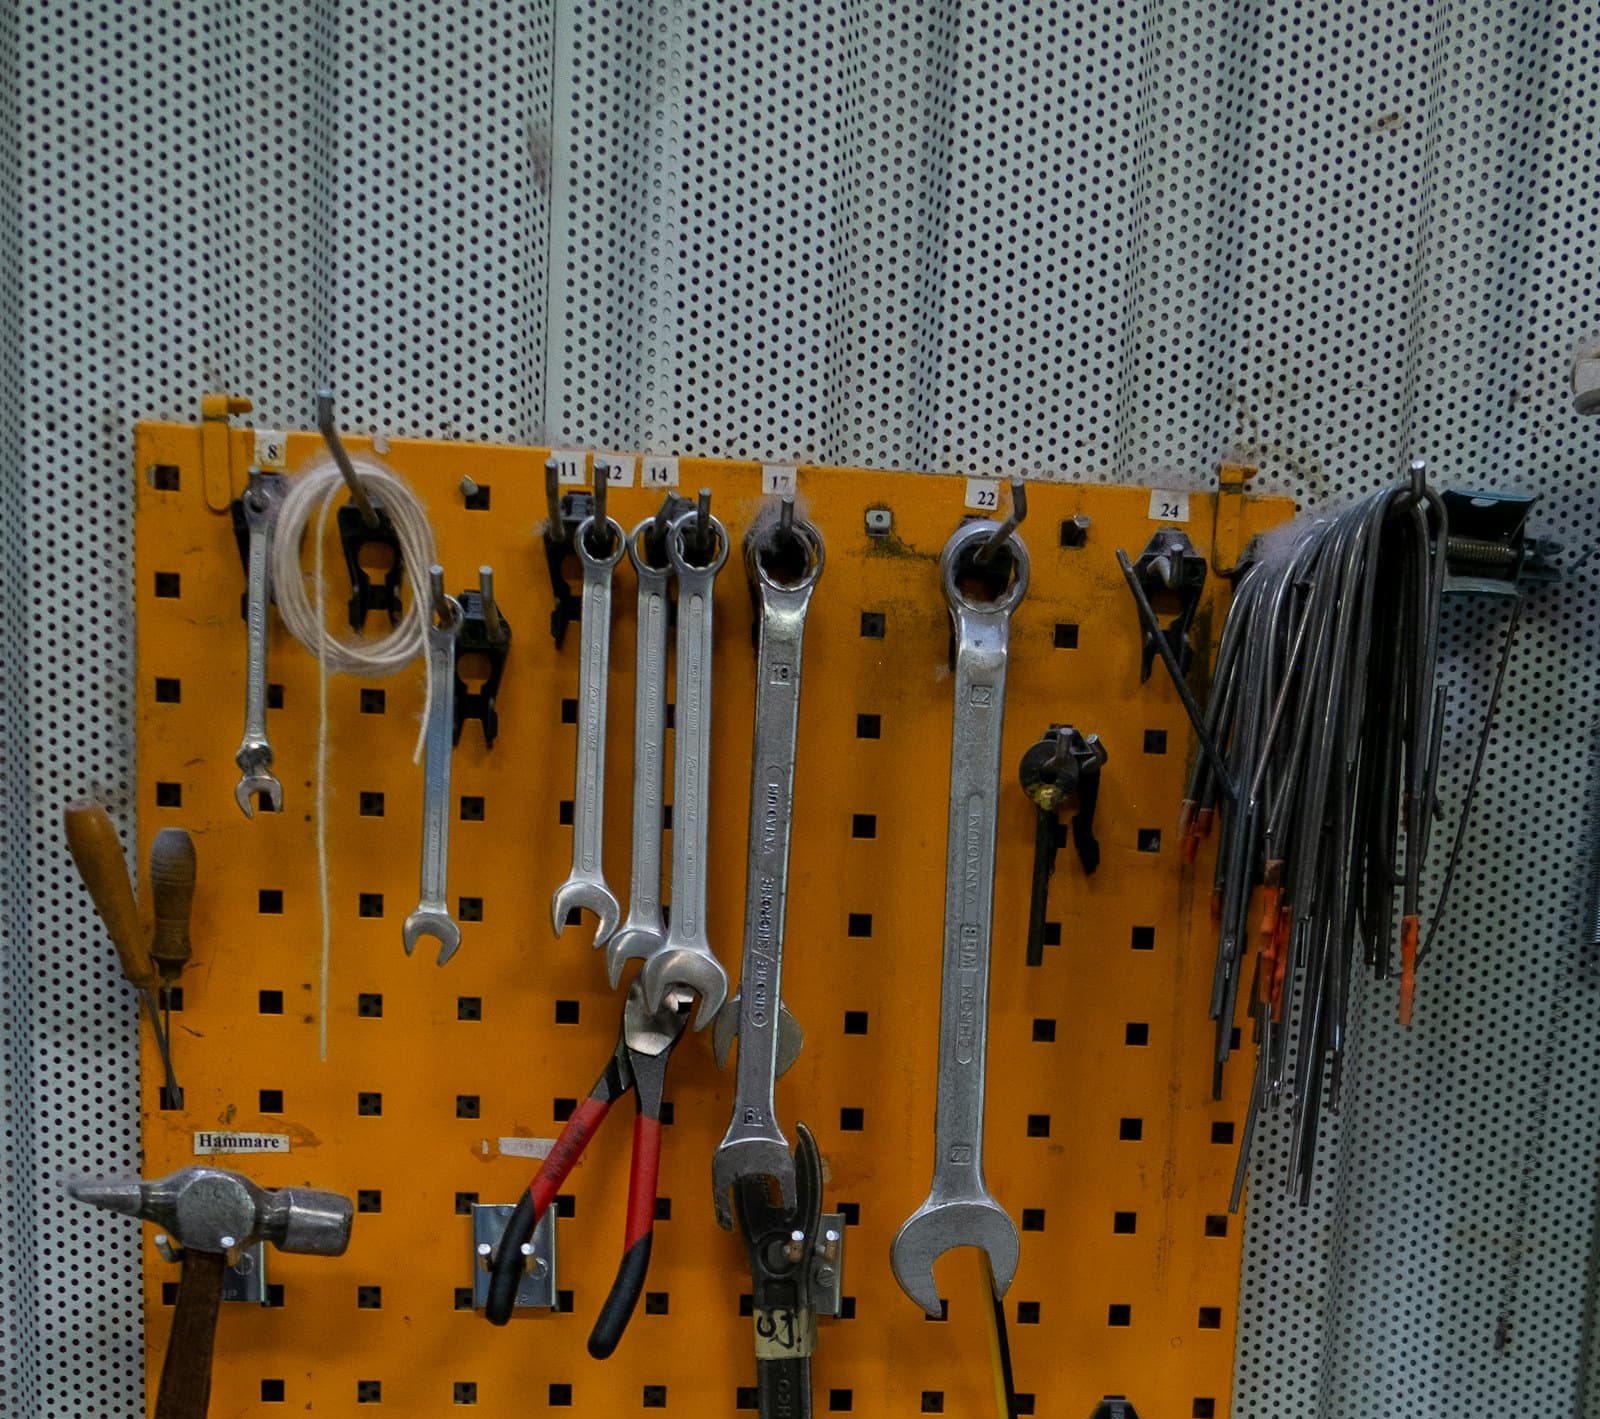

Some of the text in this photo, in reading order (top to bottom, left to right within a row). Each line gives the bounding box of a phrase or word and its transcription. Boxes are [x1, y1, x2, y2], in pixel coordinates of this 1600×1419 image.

[267, 443, 278, 460] 8
[560, 461, 577, 477] 11
[606, 465, 622, 480] 12
[651, 467, 668, 482] 14
[772, 475, 789, 490] 17
[977, 490, 996, 506] 22
[1160, 503, 1179, 518] 24
[963, 814, 981, 905] VANADIUM
[199, 1133, 280, 1149] Hammare
